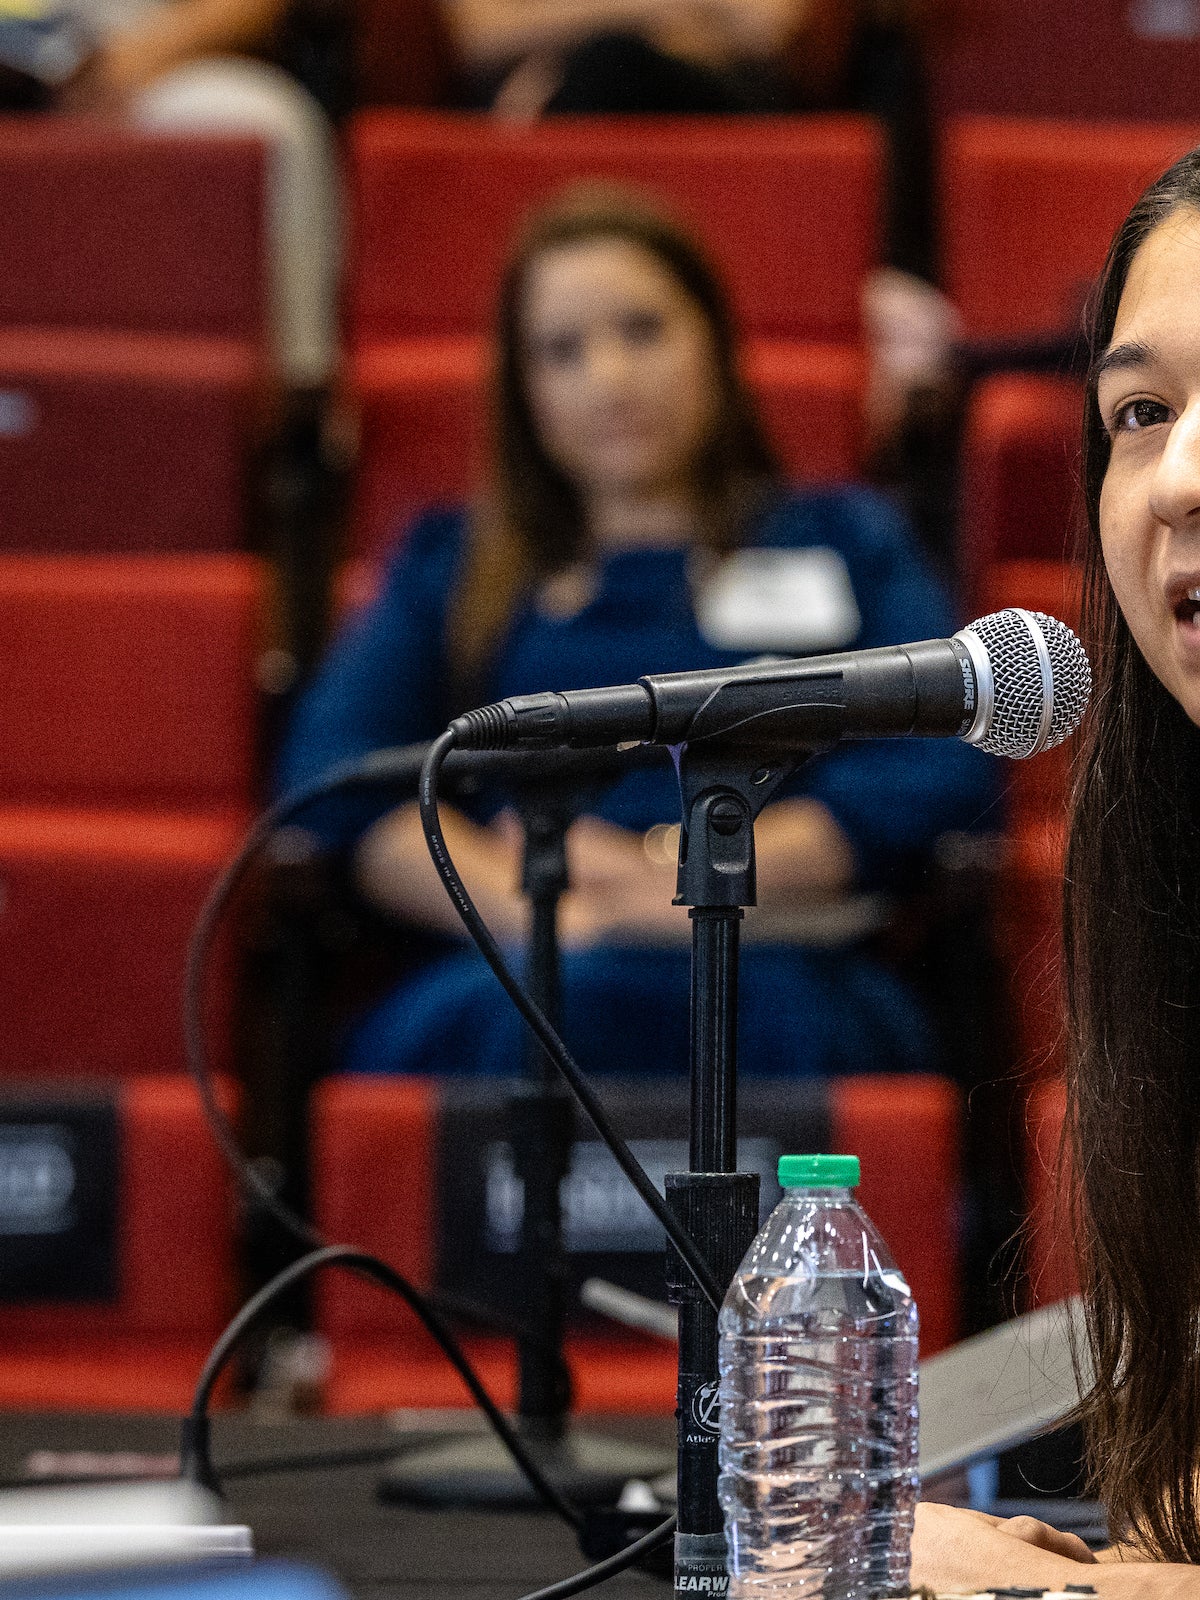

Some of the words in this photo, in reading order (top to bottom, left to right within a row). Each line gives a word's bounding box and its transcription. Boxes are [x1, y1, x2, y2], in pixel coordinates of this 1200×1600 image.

[959, 658, 975, 710] SHURE
[431, 834, 445, 864] MADE
[443, 865, 452, 878] IN
[450, 881, 469, 912] JAPAN
[688, 1564, 725, 1572] PROPER
